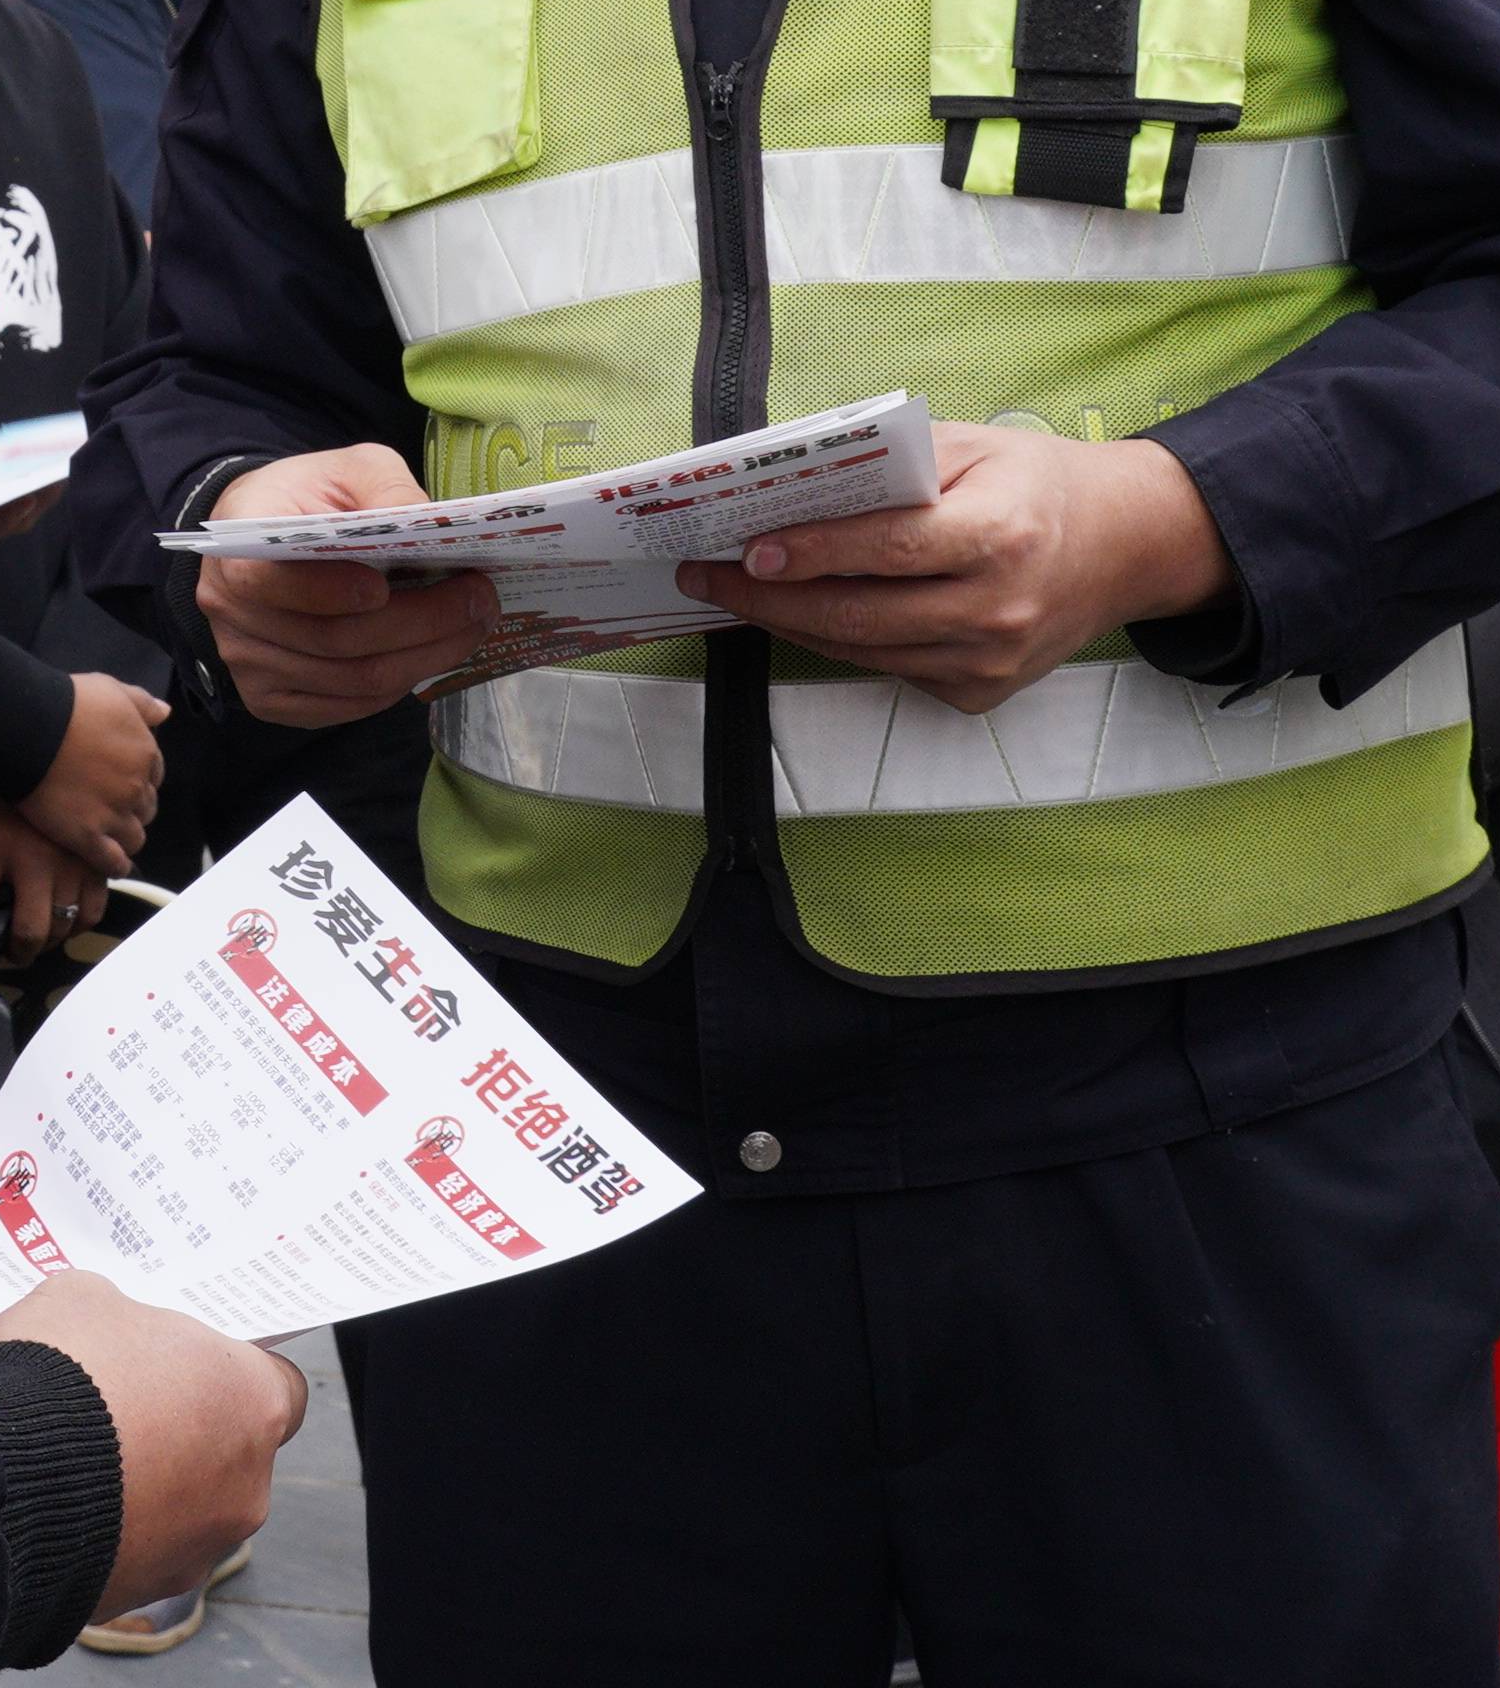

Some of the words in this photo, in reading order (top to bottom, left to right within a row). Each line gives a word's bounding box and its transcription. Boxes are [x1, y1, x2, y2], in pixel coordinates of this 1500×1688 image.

[592, 423, 881, 503] 拒绝酒驾
[128, 1030, 148, 1054] 再次
[162, 1000, 184, 1024] 饮酒
[252, 973, 364, 1090] 法律成本
[269, 840, 461, 1042] 珍爱生命
[461, 1049, 644, 1214] 拒绝酒驾
[117, 1039, 139, 1063] 饮酒
[75, 1083, 132, 1151] 发生重大交通事
[84, 1073, 142, 1143] 饮酒和醉酒驾驶
[433, 1167, 522, 1250] 经济成本
